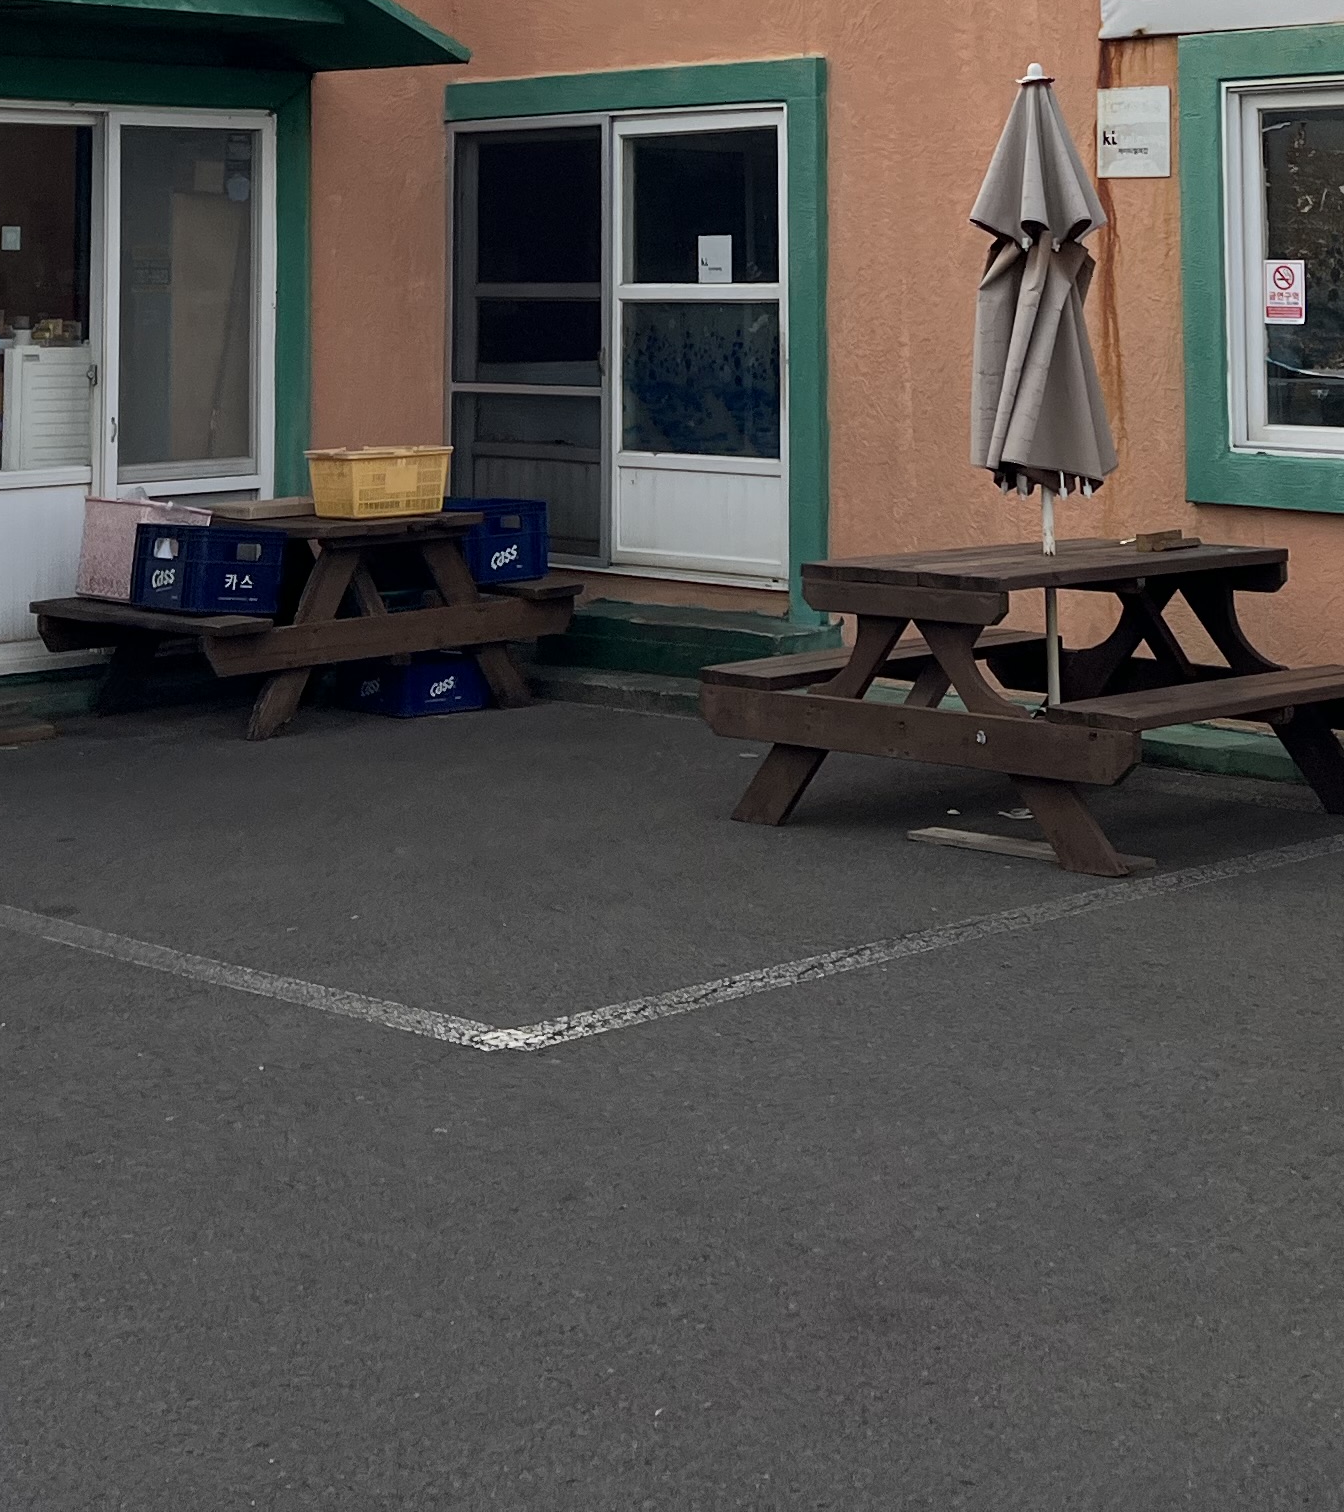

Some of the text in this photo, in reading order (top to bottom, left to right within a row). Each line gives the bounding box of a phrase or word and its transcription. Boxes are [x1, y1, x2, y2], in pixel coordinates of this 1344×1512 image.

[490, 544, 518, 570] Cass
[151, 568, 176, 589] Cass
[224, 574, 254, 590] 카스
[429, 676, 455, 697] Cass
